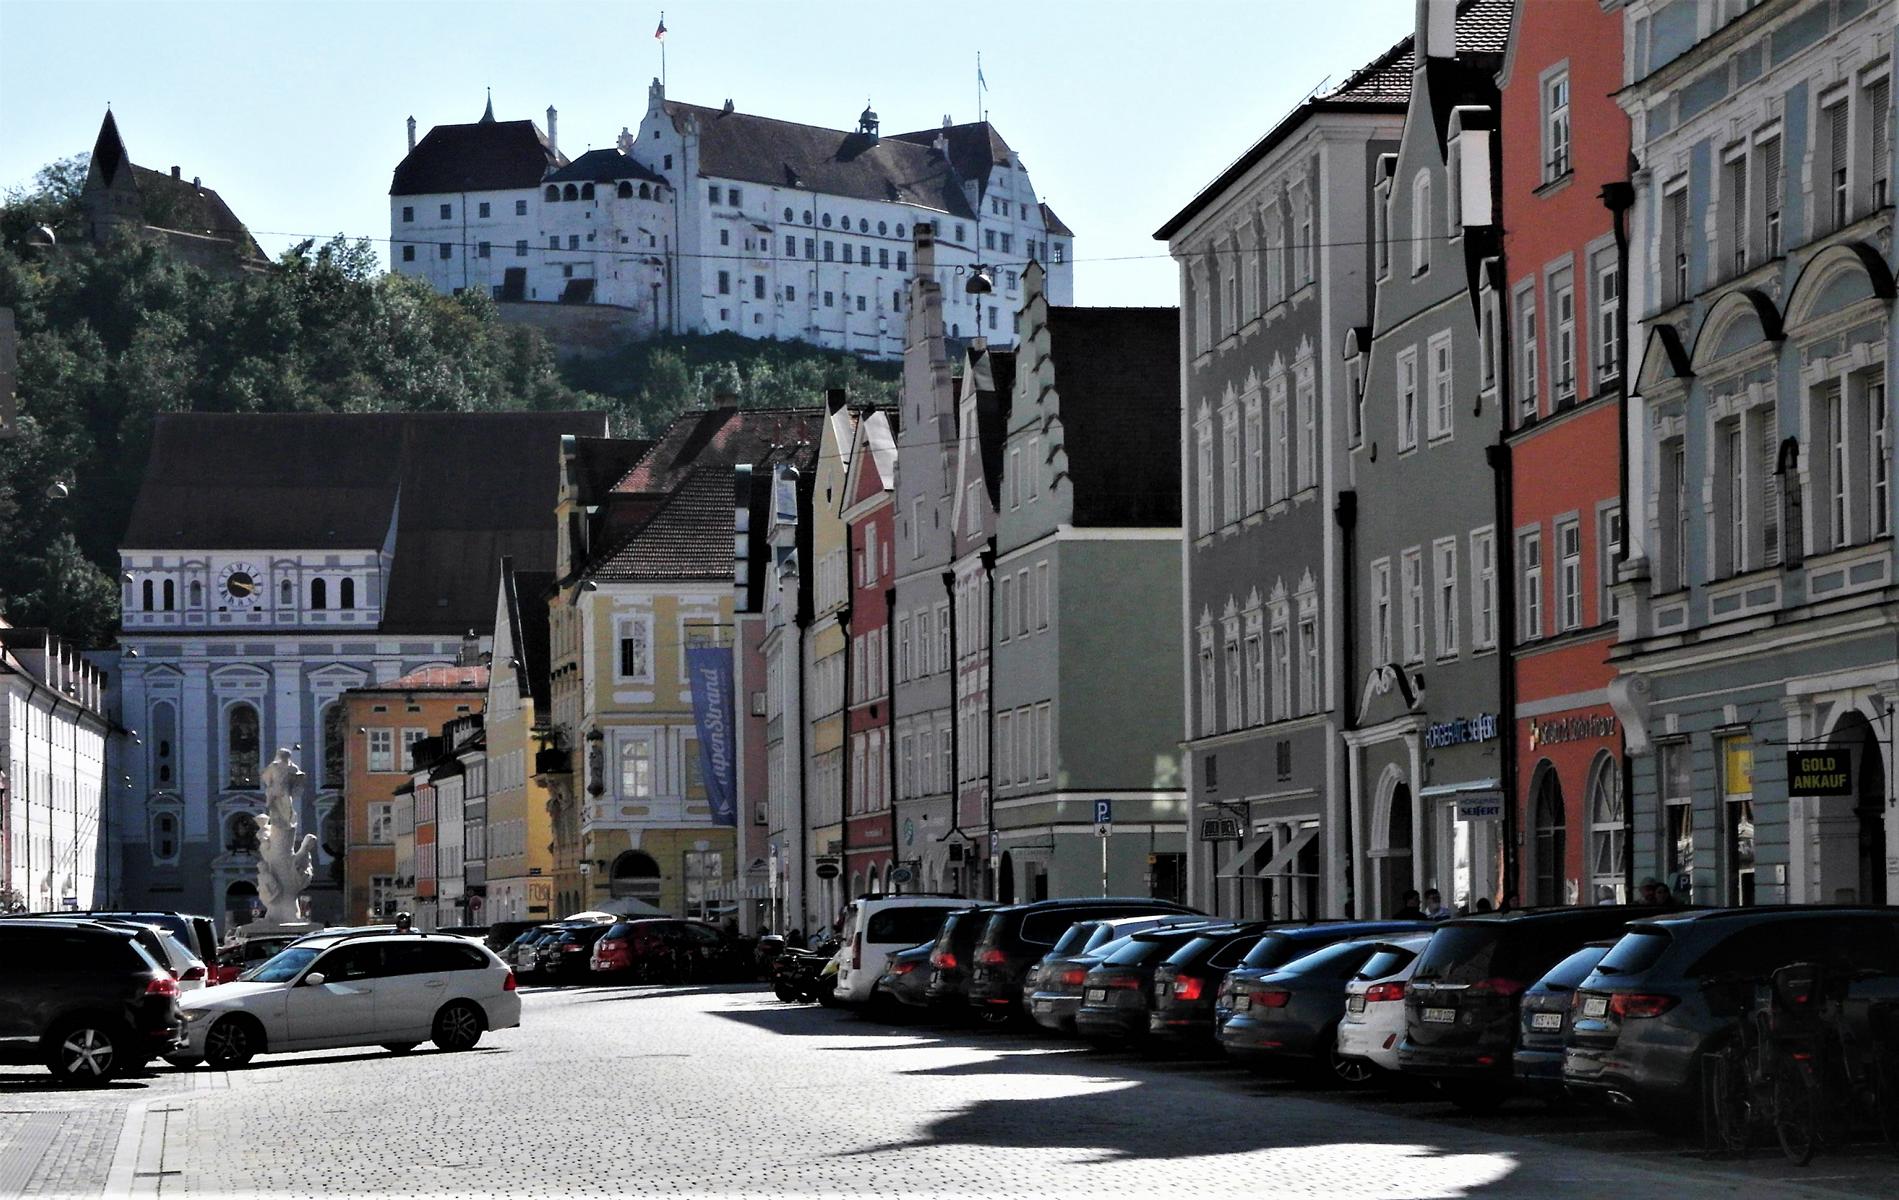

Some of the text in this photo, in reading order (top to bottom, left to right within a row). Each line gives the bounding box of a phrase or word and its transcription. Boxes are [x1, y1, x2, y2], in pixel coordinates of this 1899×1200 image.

[1801, 757, 1836, 772] GOLD
[1793, 774, 1847, 789] ANKAUF
[1098, 802, 1108, 822] P
